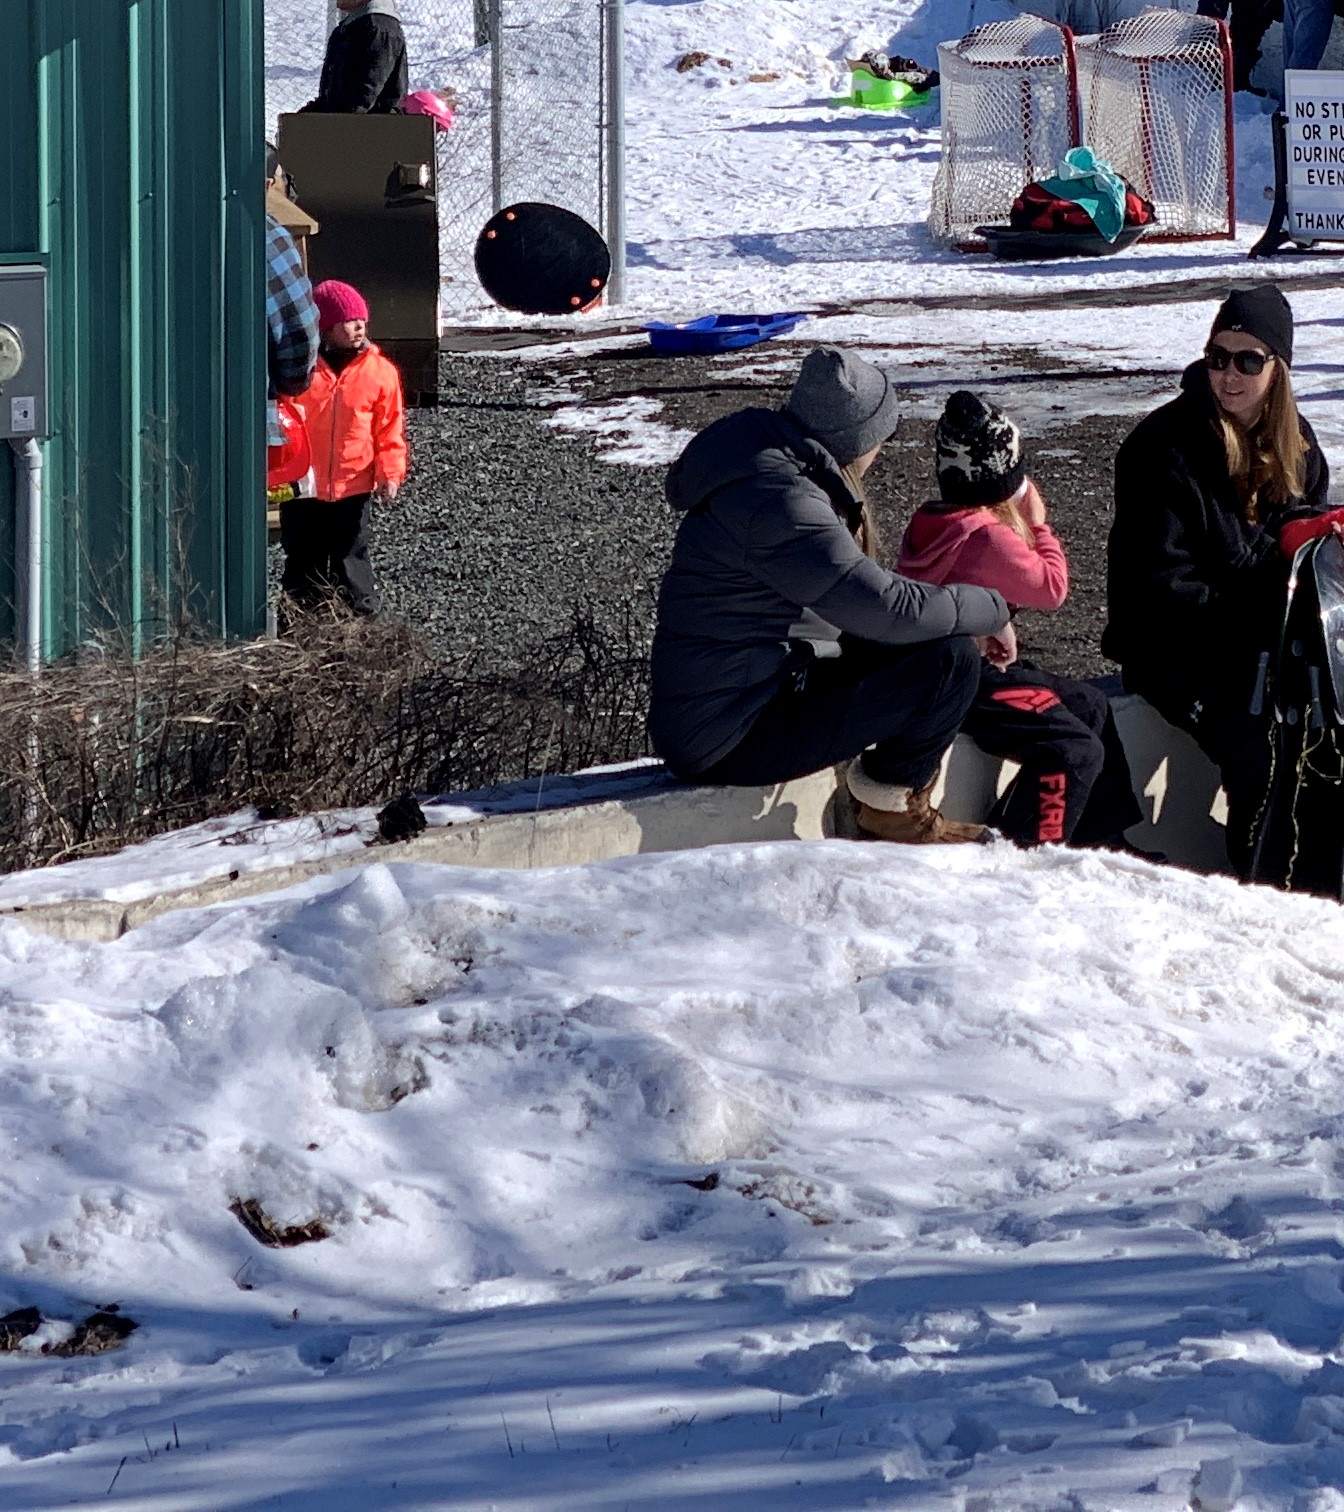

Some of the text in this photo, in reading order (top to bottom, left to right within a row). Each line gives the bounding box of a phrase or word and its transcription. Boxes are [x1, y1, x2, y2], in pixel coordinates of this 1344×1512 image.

[1295, 101, 1315, 118] NO
[1302, 123, 1321, 140] OR
[1295, 212, 1344, 230] THANK
